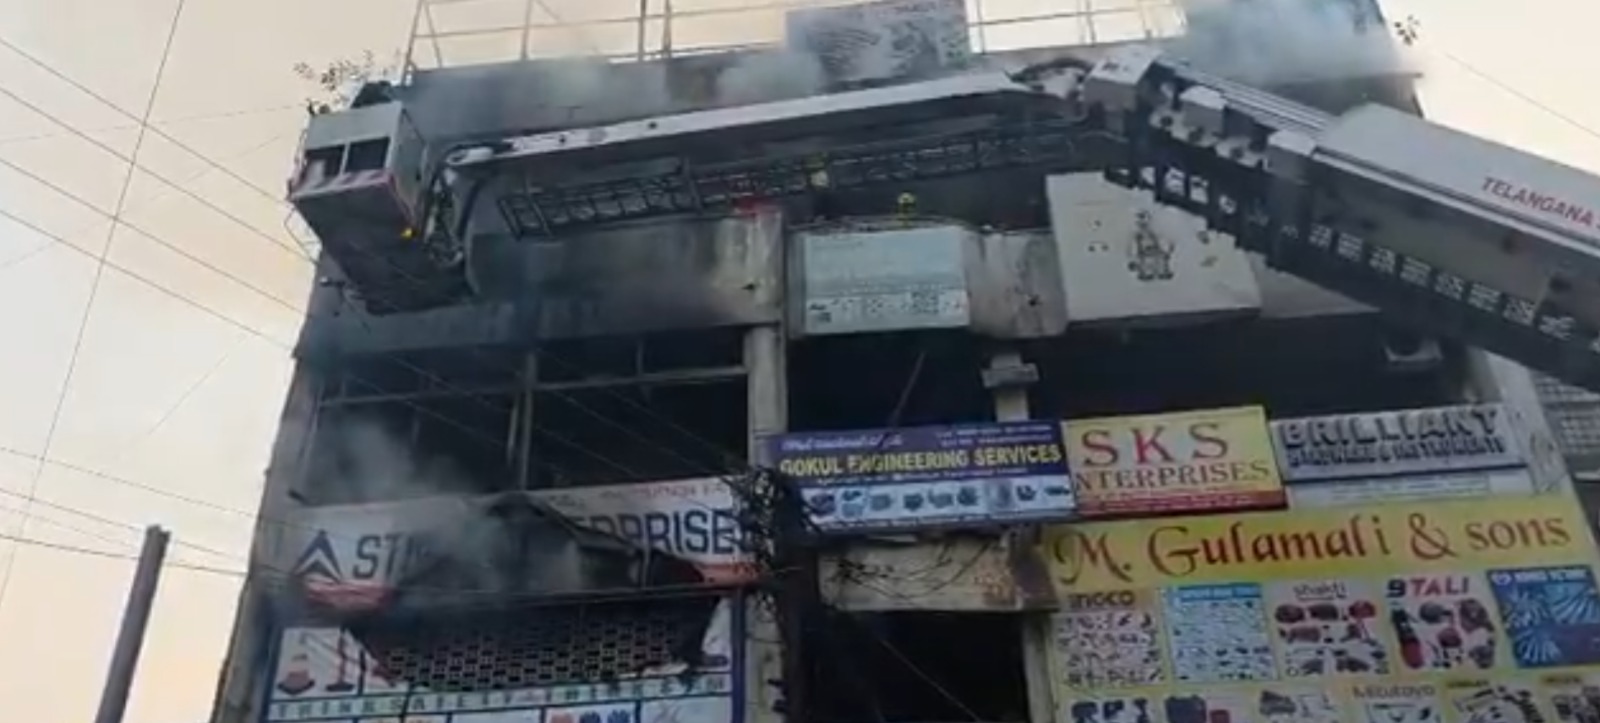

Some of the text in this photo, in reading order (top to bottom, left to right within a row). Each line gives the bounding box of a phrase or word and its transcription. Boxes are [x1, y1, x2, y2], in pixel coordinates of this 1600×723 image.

[1482, 177, 1593, 226] TELANGANA
[1282, 409, 1498, 450] BRILLIANT
[780, 443, 1062, 476] GOKUL ENGINEERING SERVICES
[1074, 459, 1270, 493] NTERPRISES
[1408, 512, 1460, 560] &
[1468, 517, 1572, 552] sons
[277, 700, 375, 718] THINK
